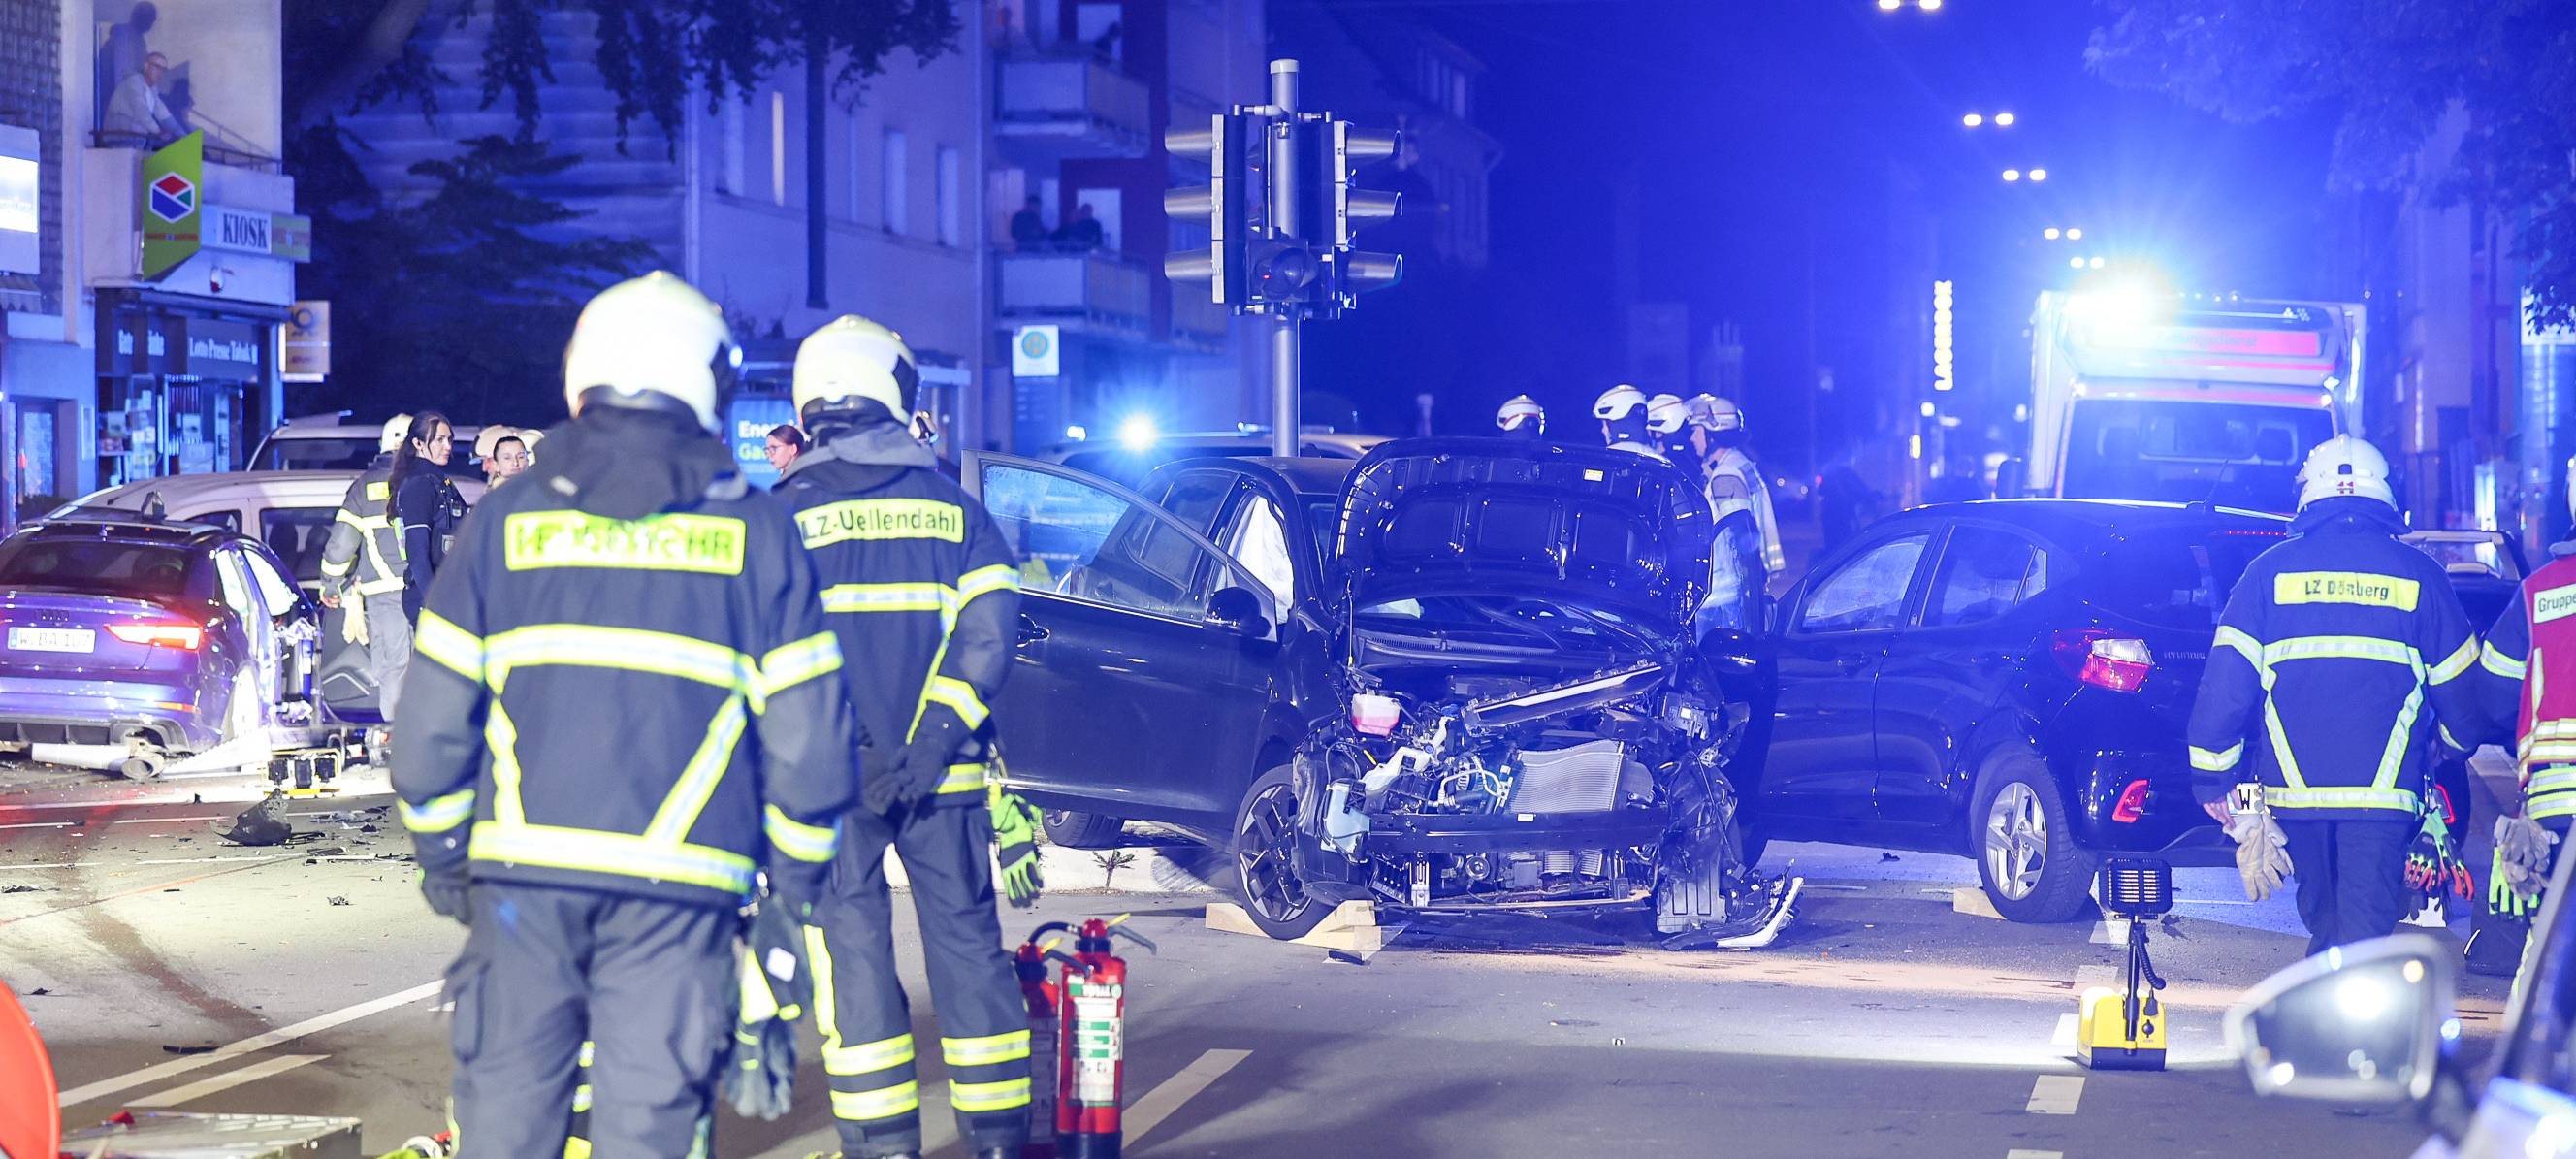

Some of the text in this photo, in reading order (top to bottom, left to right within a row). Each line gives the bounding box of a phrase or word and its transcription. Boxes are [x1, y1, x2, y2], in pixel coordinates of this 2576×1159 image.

[222, 212, 268, 249] KIOSK
[2304, 579, 2321, 595] LZ
[2238, 789, 2251, 810] W
